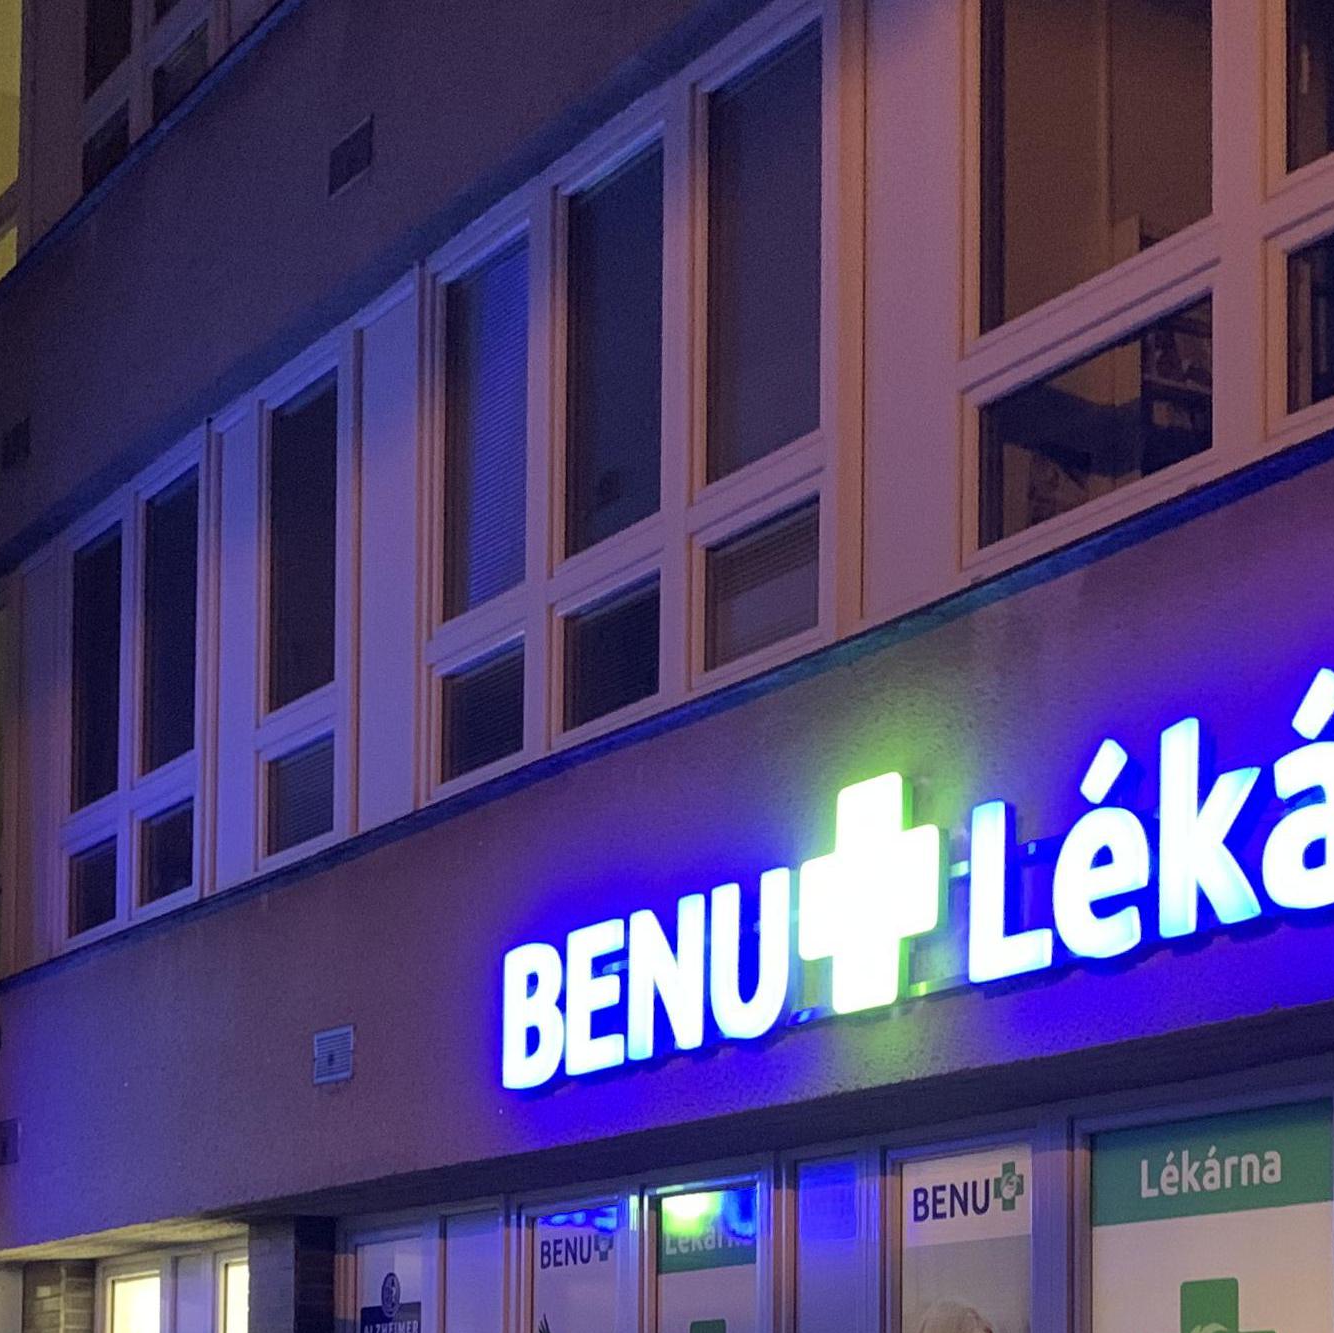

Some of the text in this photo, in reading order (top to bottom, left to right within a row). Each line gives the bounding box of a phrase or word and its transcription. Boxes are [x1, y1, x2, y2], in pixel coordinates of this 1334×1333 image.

[502, 867, 790, 1090] BENU
[1141, 1144, 1282, 1199] Lékárna
[913, 1178, 990, 1222] BENU
[540, 1234, 593, 1270] BENU
